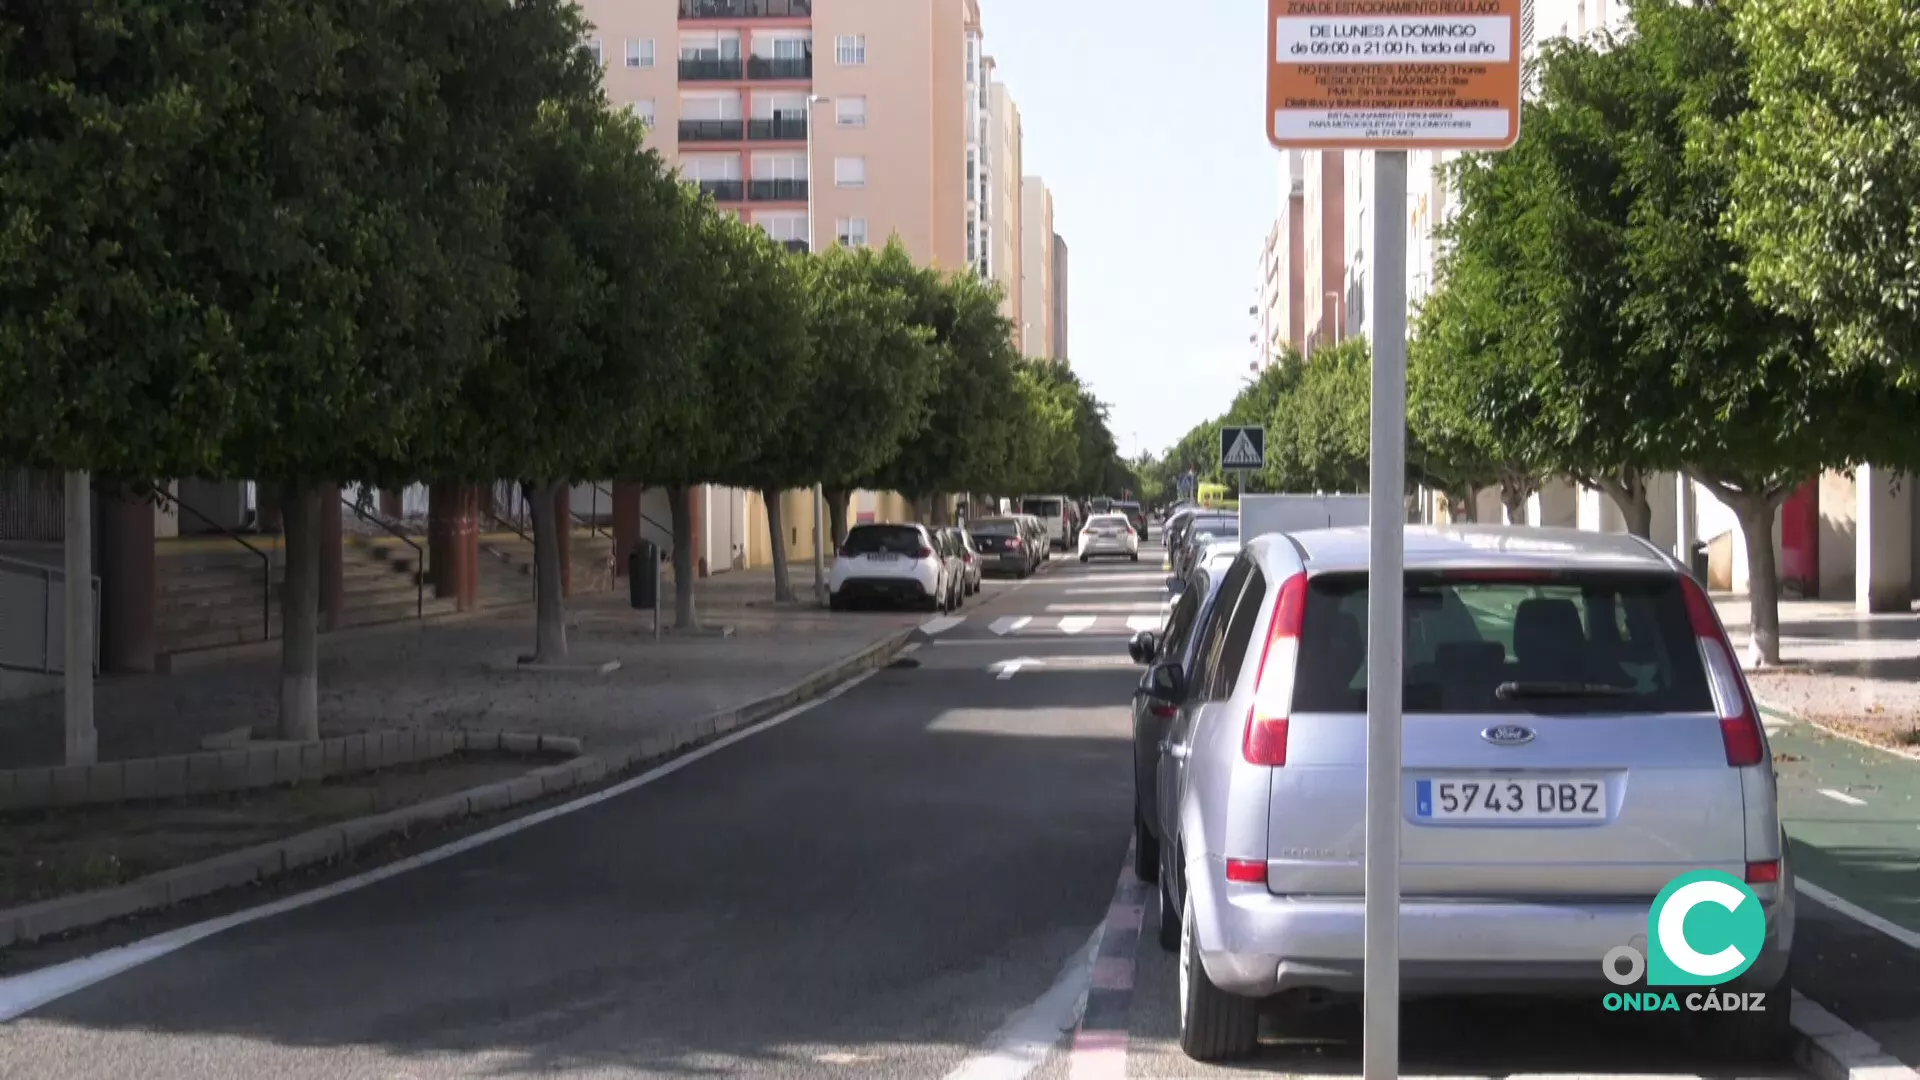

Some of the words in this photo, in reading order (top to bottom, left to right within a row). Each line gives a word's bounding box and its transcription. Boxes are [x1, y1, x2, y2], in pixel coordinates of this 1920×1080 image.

[1287, 1, 1317, 14] ZONA
[1319, 1, 1332, 14] DE
[1335, 1, 1437, 14] ESTACIONAMIENTO
[1440, 1, 1499, 14] REGULADO
[1309, 24, 1331, 38] DE
[1334, 24, 1385, 38] LUNES
[1387, 24, 1398, 38] A
[1401, 24, 1476, 38] DOMINGO
[1290, 41, 1308, 55] de
[1310, 41, 1349, 55] 09:00
[1363, 41, 1402, 55] 21:00
[1421, 41, 1452, 55] todo
[1454, 41, 1466, 55] el
[1469, 41, 1495, 55] año
[1439, 783, 1524, 813] 5743
[1536, 783, 1599, 813] DBZ
